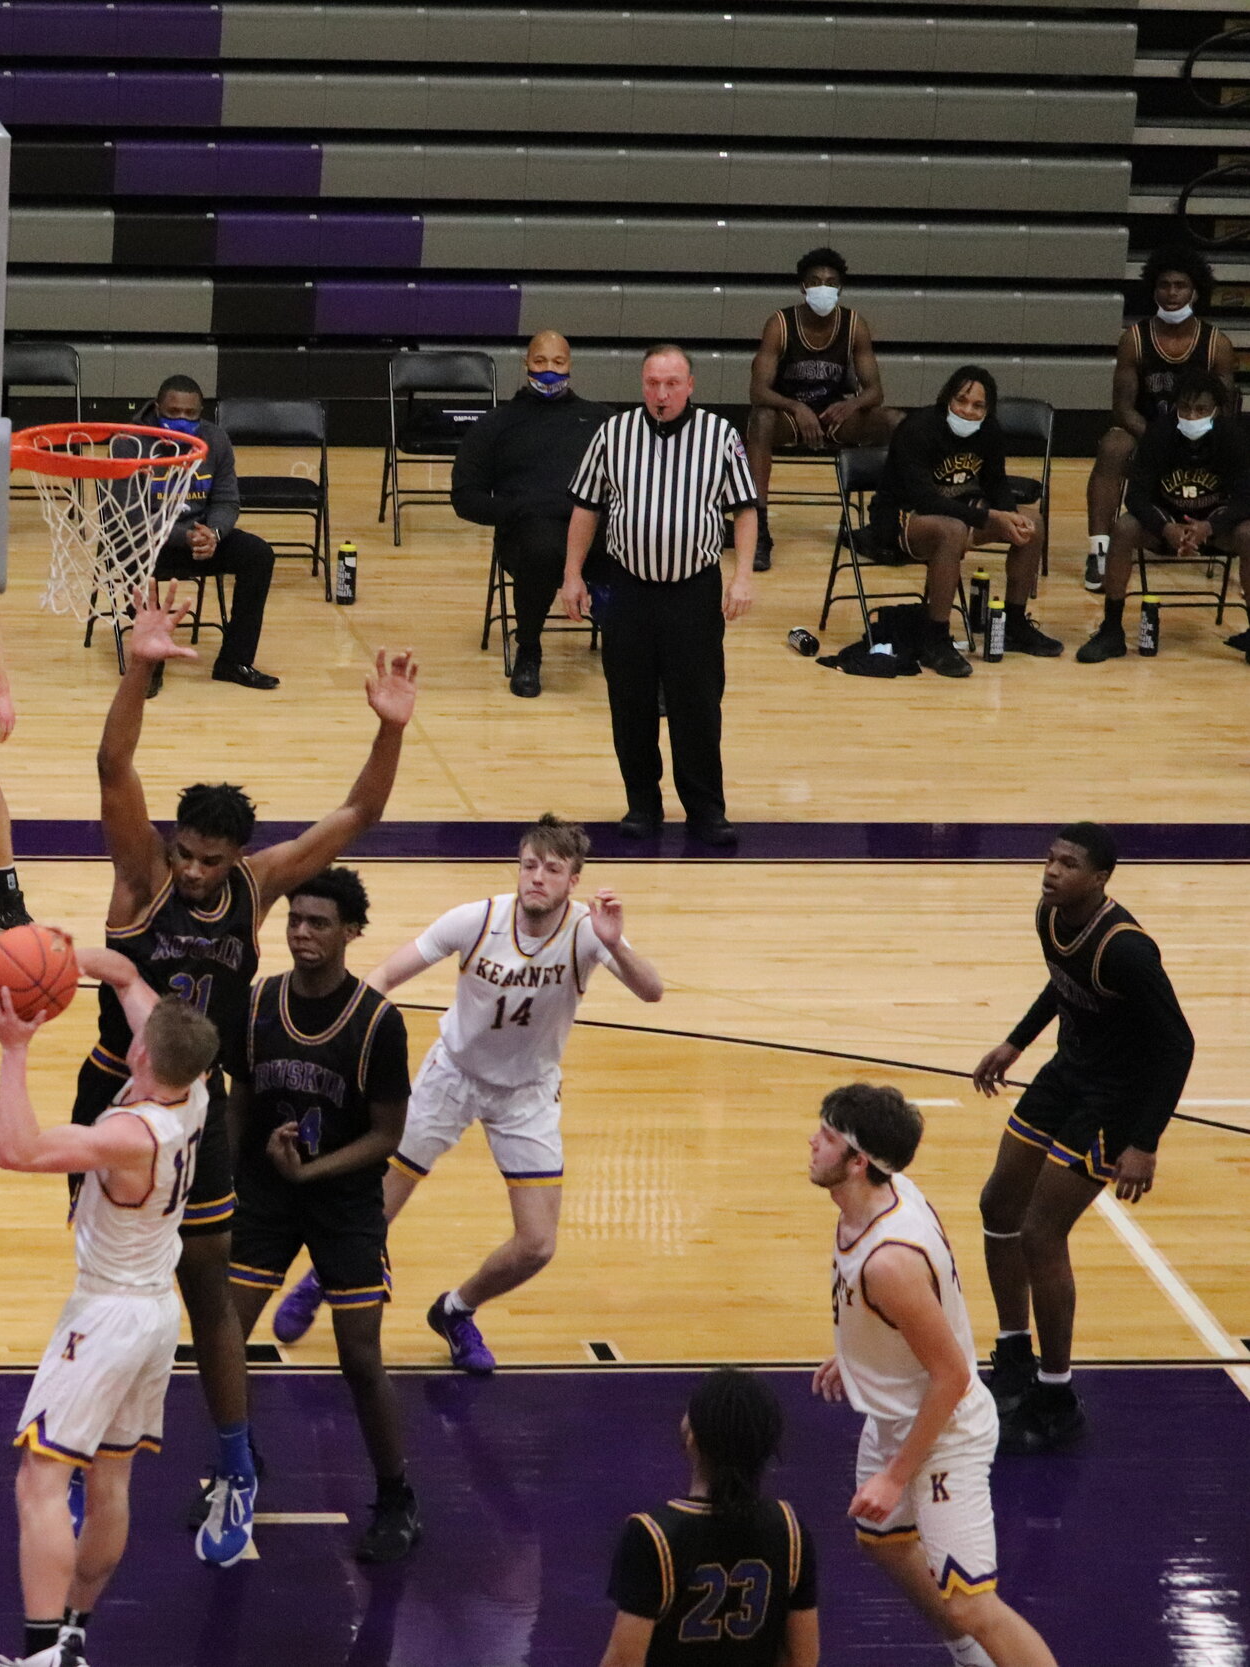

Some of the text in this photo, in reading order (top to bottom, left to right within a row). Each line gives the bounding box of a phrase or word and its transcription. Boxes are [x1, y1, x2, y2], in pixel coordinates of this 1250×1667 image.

[476, 957, 566, 988] KEARNEY
[490, 995, 534, 1029] 14
[254, 1058, 346, 1108] RUSKIN
[61, 1331, 86, 1361] K
[930, 1472, 950, 1503] K
[678, 1558, 772, 1641] 23
